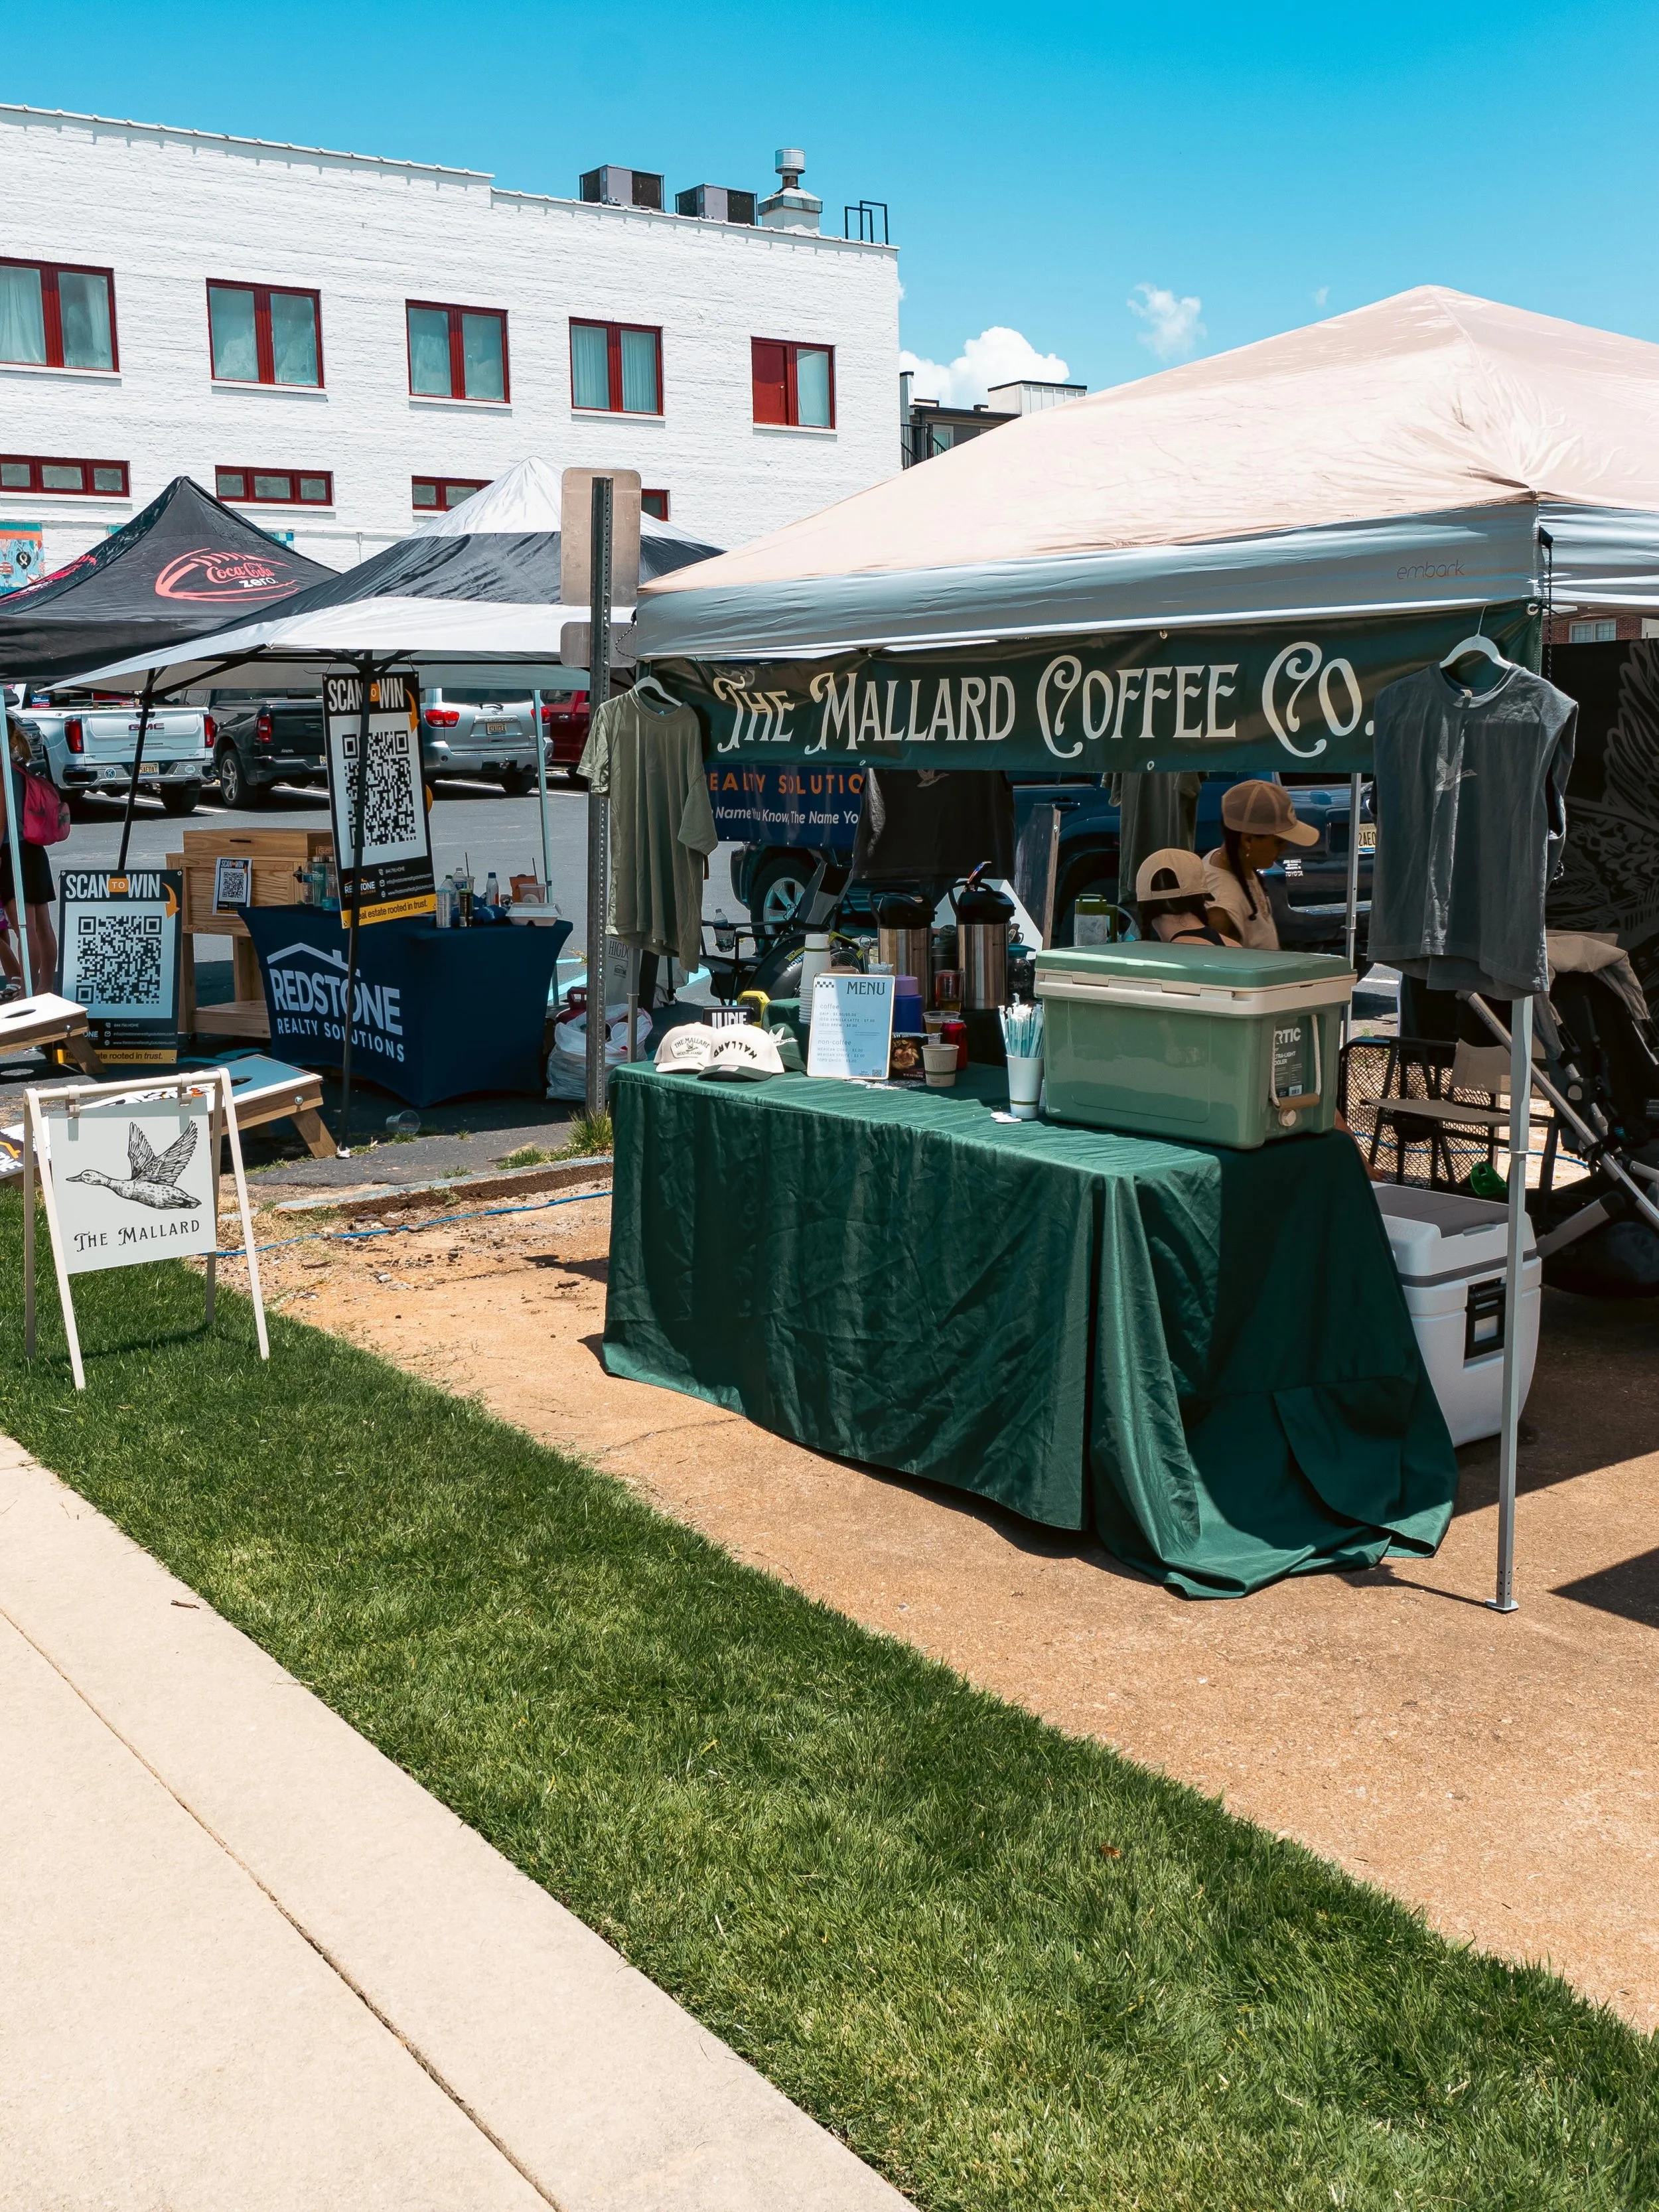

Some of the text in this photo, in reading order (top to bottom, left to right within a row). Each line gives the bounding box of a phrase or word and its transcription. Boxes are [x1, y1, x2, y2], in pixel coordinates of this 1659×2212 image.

[1396, 559, 1465, 579] embark
[328, 679, 364, 711] SCAN
[376, 678, 404, 709] WIN
[713, 641, 1374, 759] THE MALLARD COFFEE CO.
[707, 772, 863, 794] EALTY SOLUTIO
[716, 806, 751, 819] Name
[790, 810, 805, 823] The
[809, 811, 839, 824] Name
[843, 810, 859, 824] Yo
[66, 874, 110, 899] SCAN
[126, 874, 160, 899] WIN
[344, 881, 376, 894] RETONE
[368, 908, 388, 919] estate
[388, 903, 407, 914] rooted
[407, 902, 413, 911] in
[413, 899, 428, 909] trust.
[846, 981, 885, 995] MENU
[269, 968, 403, 1036] REDSTONE
[277, 1017, 318, 1036] REALTY
[1274, 1027, 1301, 1045] RTIC
[674, 1038, 684, 1048] THE
[713, 1041, 757, 1059] MALLARD
[1274, 1051, 1297, 1060] TRA-LIGHT
[74, 1220, 200, 1252] THE MALLARD
